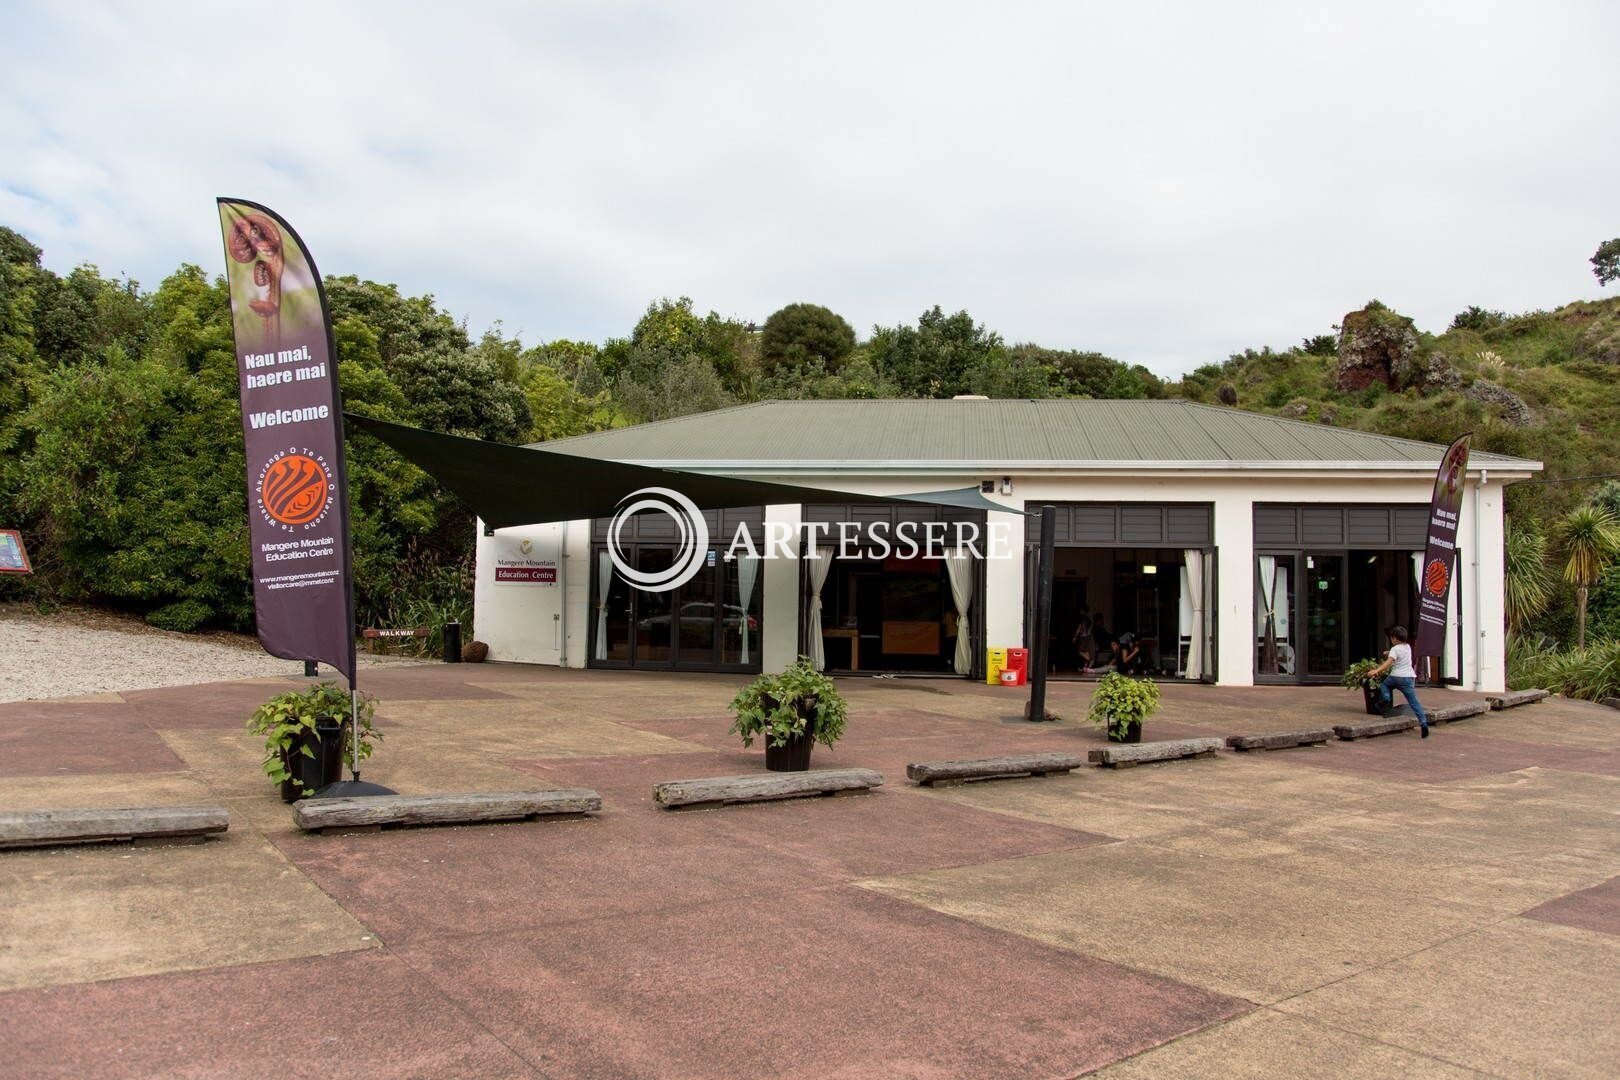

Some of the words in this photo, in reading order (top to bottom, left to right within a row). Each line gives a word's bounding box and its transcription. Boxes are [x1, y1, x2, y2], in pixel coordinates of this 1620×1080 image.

[244, 353, 275, 370] Nau
[277, 345, 312, 364] mai,
[246, 370, 293, 389] haere
[295, 362, 326, 381] mai
[249, 404, 329, 430] Welcome
[290, 446, 297, 454] O
[302, 447, 314, 457] Te
[255, 449, 286, 493] Akoranga
[316, 455, 333, 478] Pane
[328, 483, 335, 491] O
[257, 498, 277, 528] Whare
[261, 541, 299, 552] Mangere
[300, 536, 334, 548] Mountain
[265, 551, 308, 562] Education
[309, 547, 334, 558] Centre
[497, 559, 525, 568] Mangere
[525, 559, 556, 567] Mountain
[498, 570, 529, 578] Education
[532, 571, 554, 579] Centre
[379, 629, 415, 637] WALKWAY
